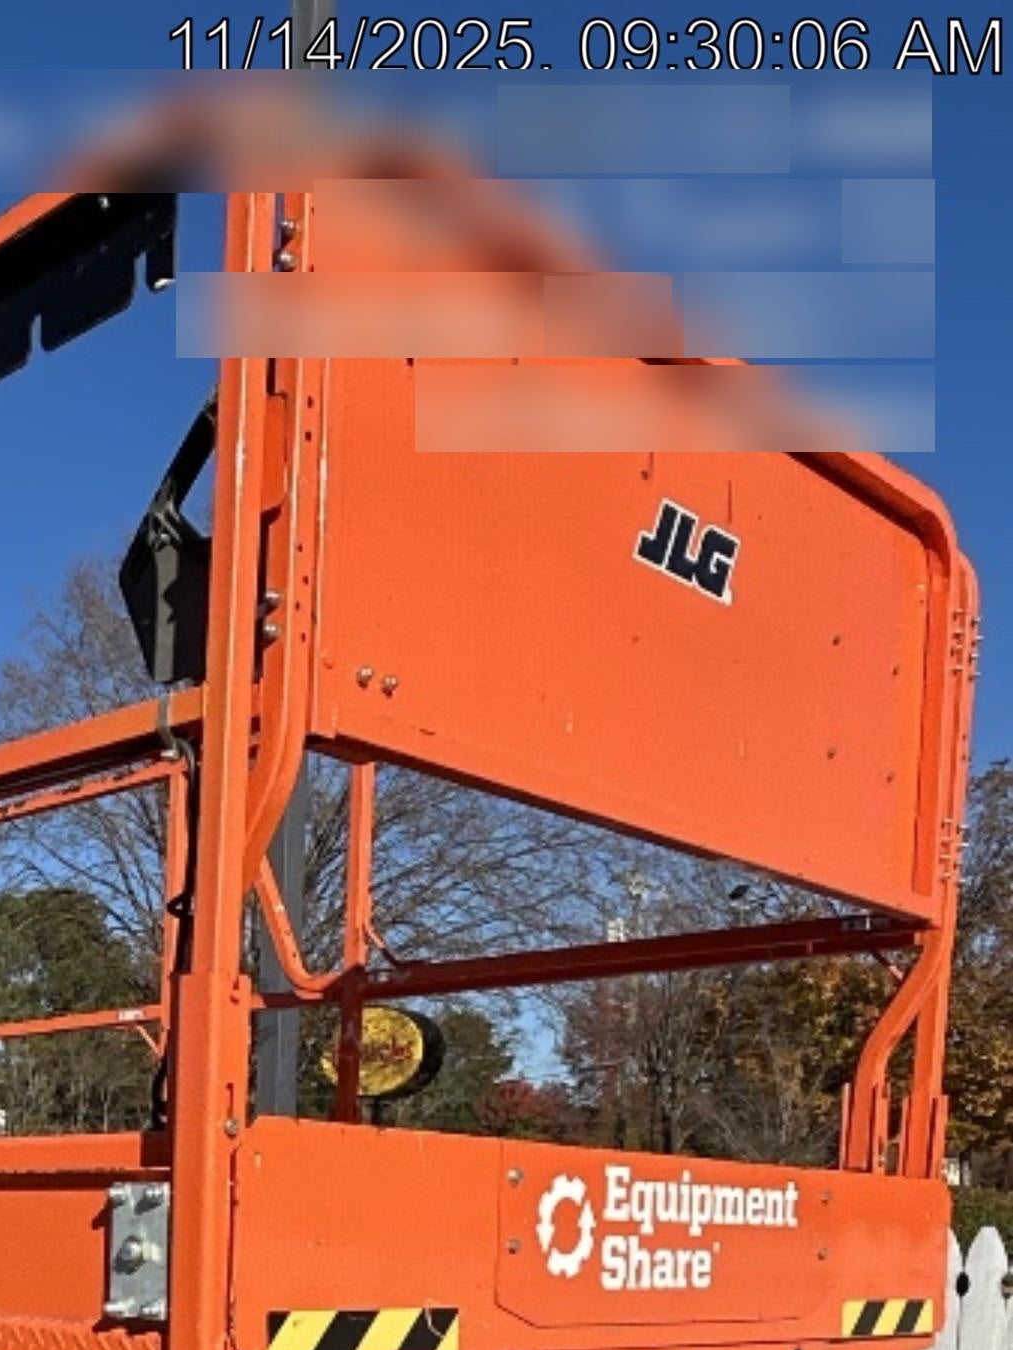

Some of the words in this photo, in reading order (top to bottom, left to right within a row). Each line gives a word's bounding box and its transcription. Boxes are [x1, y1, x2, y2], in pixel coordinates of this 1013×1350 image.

[633, 498, 741, 606] JLG
[603, 1164, 799, 1237] Equipment
[601, 1235, 712, 1291] Share
